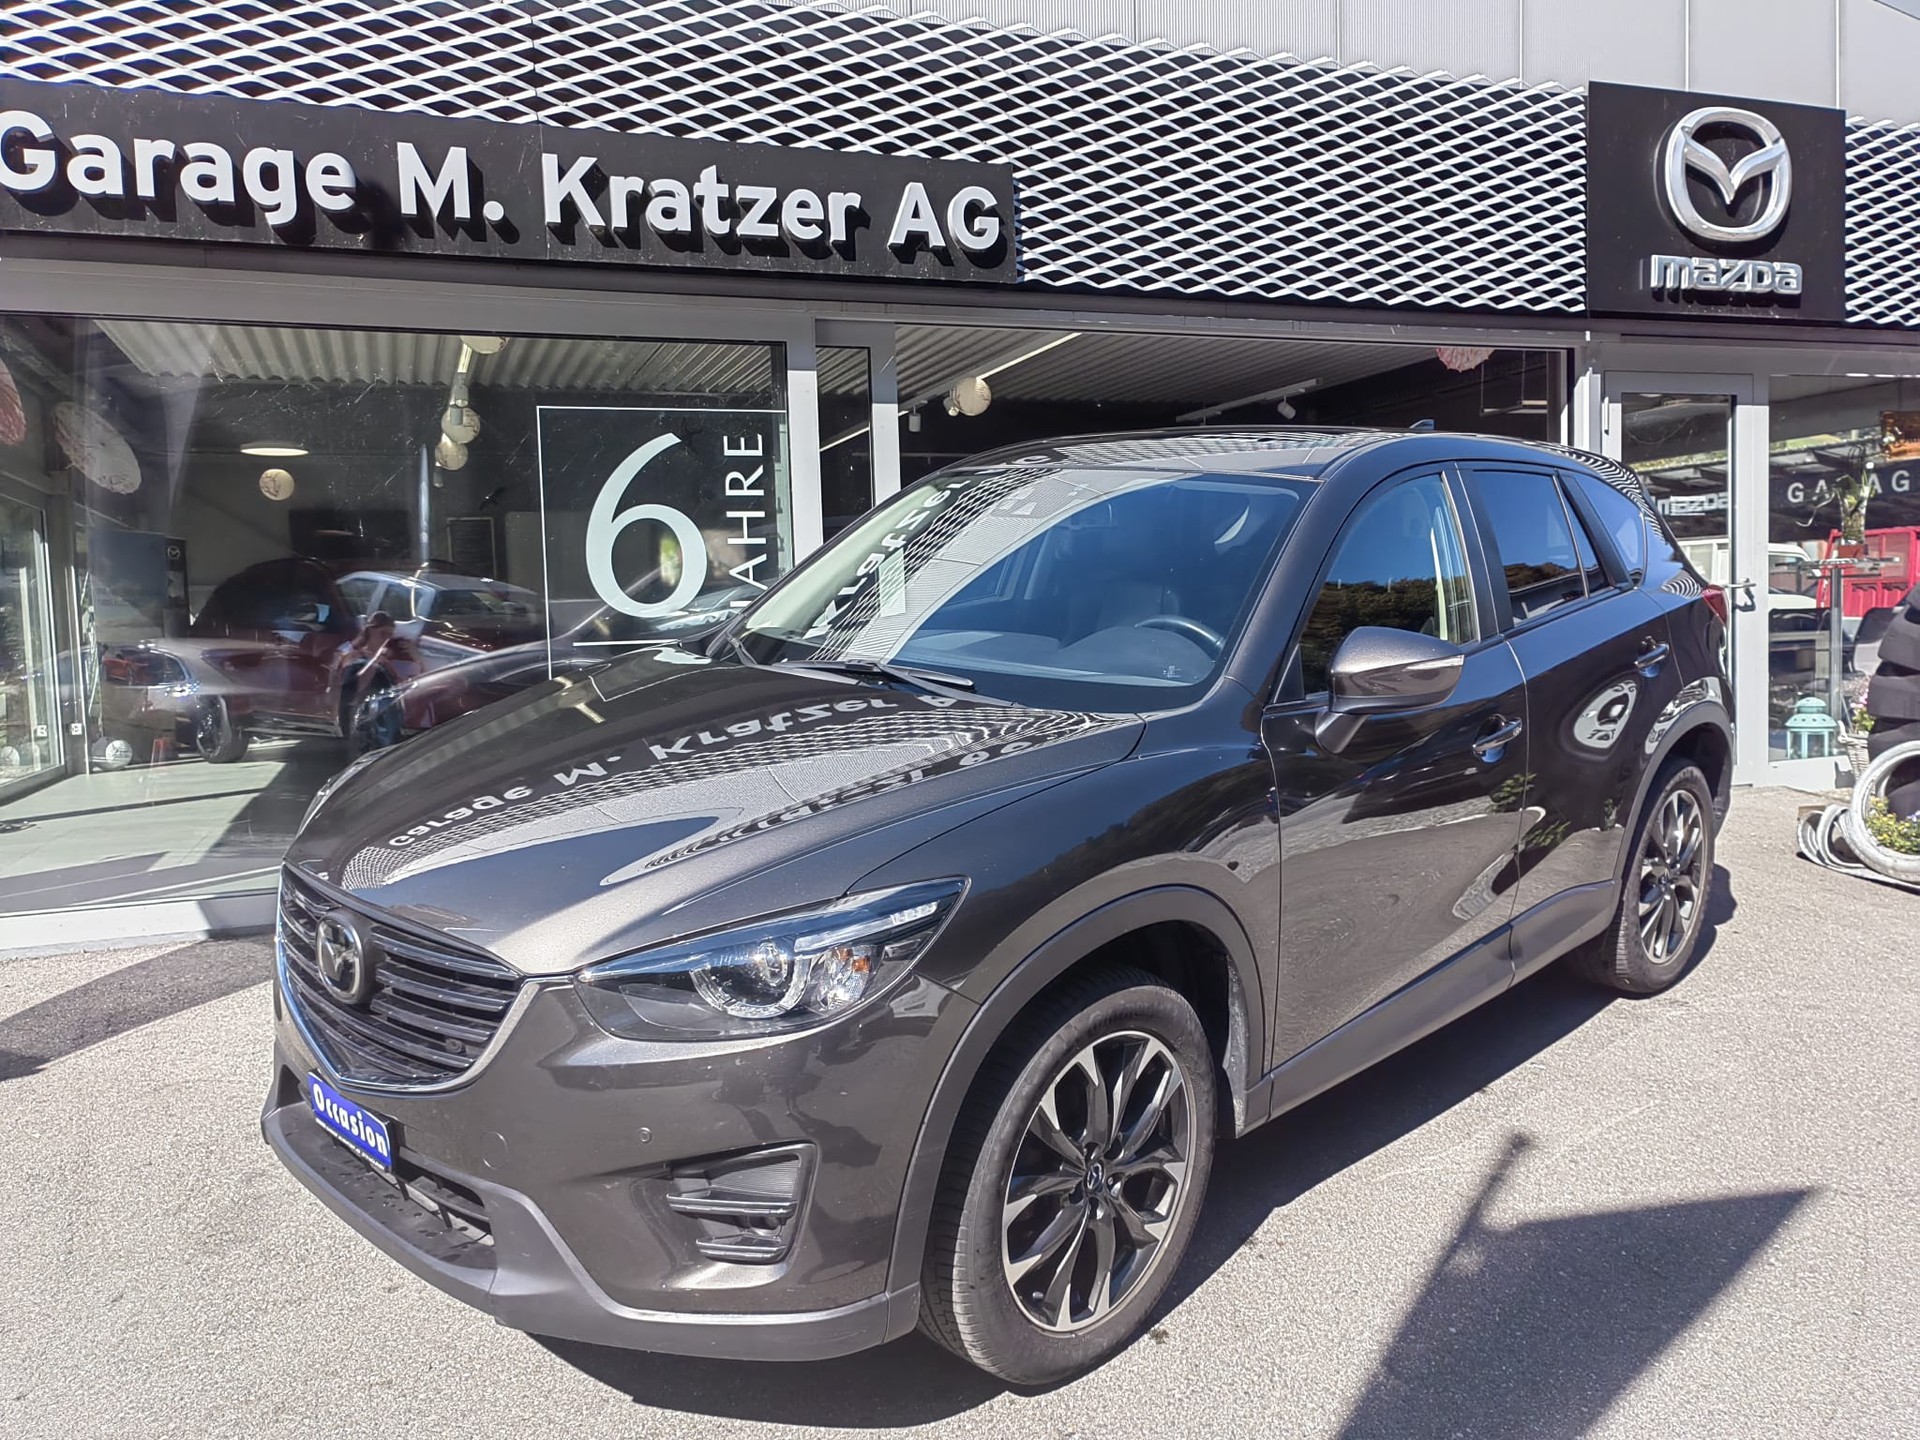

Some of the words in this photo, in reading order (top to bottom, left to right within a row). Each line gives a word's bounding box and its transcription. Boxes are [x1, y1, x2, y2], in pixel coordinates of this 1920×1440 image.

[0, 110, 356, 225] Garage
[397, 141, 505, 222] M.
[541, 153, 862, 247] Kratzer
[887, 182, 1000, 250] AG
[585, 432, 708, 618] 6
[313, 1083, 388, 1157] Occasion
